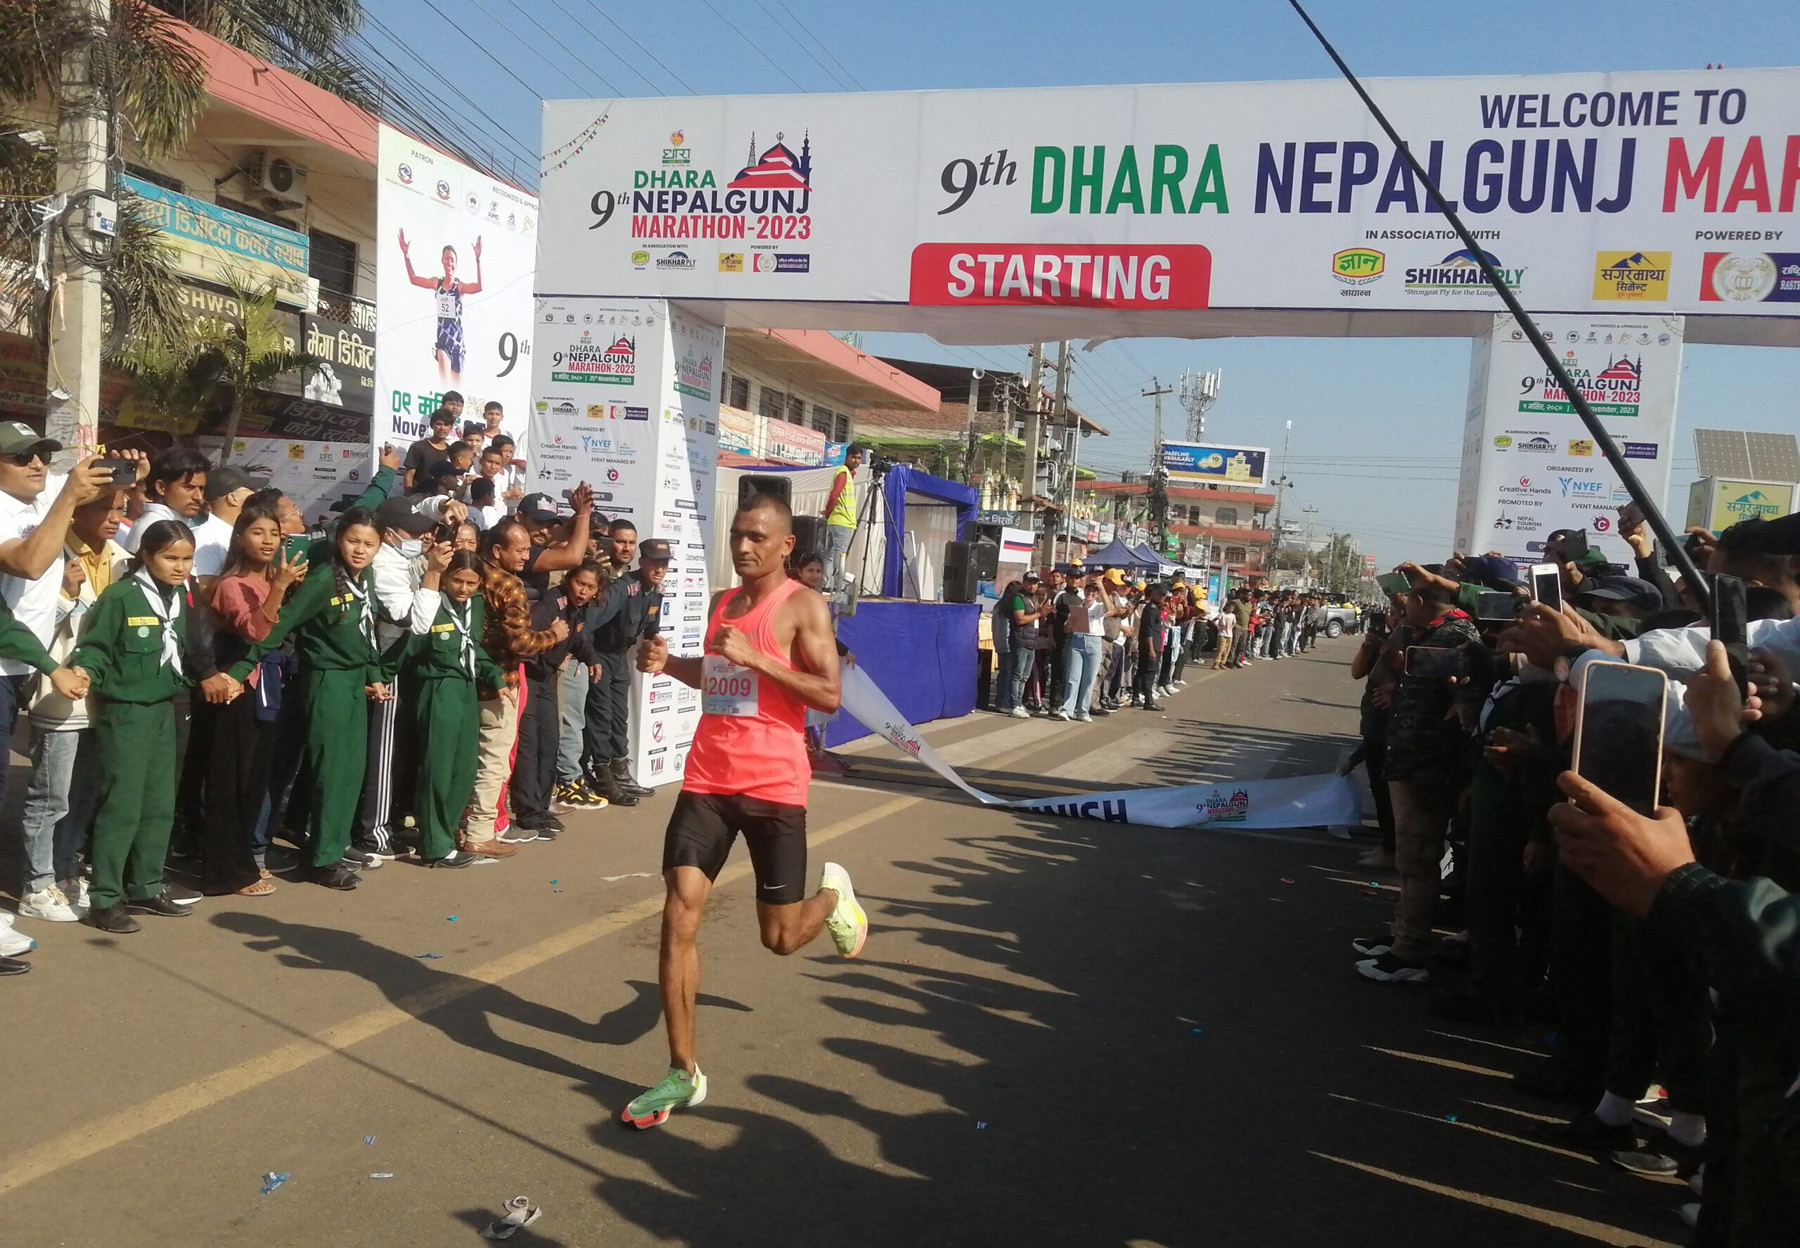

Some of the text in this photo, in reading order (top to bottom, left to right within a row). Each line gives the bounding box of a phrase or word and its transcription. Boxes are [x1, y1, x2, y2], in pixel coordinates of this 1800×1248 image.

[1480, 88, 1747, 129] WELCOME TO
[411, 149, 434, 165] PATRON
[634, 169, 717, 189] DHARA
[937, 148, 1018, 216] 9th
[1030, 143, 1230, 214] DHARA
[1254, 136, 1637, 214] NEPALGUNJ
[492, 186, 520, 202] RECOGNIZED
[589, 190, 809, 230] 9th NEPALGUNJ
[631, 214, 812, 240] MARATHON-2023
[1365, 230, 1378, 239] IN
[1468, 230, 1500, 240] WITH
[1695, 230, 1784, 240] POWERED BY
[947, 253, 1171, 300] STARTING
[1601, 269, 1666, 281] सगरमाथा
[441, 303, 450, 312] 52
[307, 321, 336, 361] मेगा
[569, 344, 601, 353] DHARA
[496, 331, 531, 378] 9th
[569, 352, 635, 365] NEPALGUNJ
[568, 362, 636, 374] MARATHON-2023
[1546, 368, 1591, 378] DARA
[1520, 376, 1640, 395] 9th NALGUNJ
[1543, 388, 1640, 403] MARHON-2023
[392, 415, 428, 438] Nove
[591, 440, 612, 448] NYEF
[1572, 482, 1603, 491] NYEF
